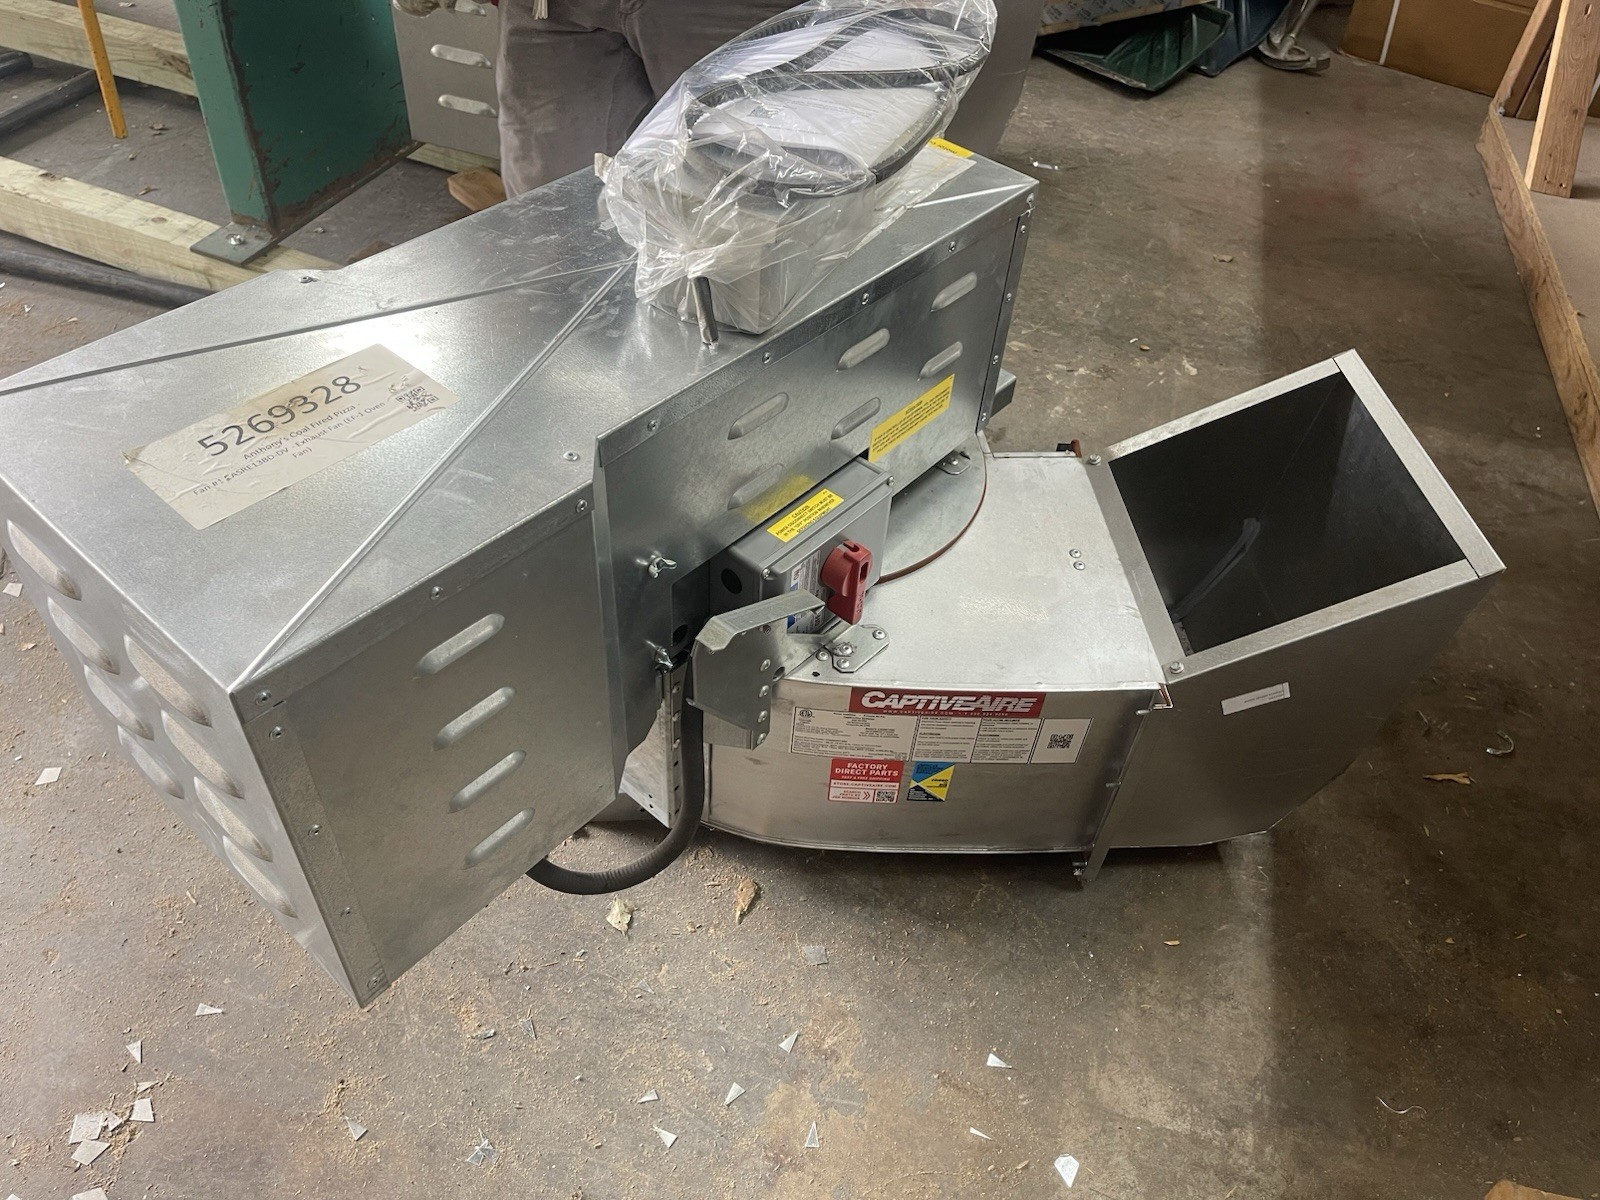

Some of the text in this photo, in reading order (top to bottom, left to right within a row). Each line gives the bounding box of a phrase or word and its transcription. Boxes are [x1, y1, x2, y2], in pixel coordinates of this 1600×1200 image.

[197, 376, 361, 456] 5269328
[243, 436, 290, 460] Anthony's
[290, 424, 311, 438] Coal
[310, 414, 335, 429] Fired
[333, 404, 356, 416] Pizza
[193, 484, 211, 496] Fan
[212, 478, 222, 487] #1
[294, 429, 328, 447] Exhaust
[327, 421, 344, 433] Fan
[342, 411, 365, 425] (EF-1
[364, 402, 386, 414] Oven
[292, 447, 313, 459] Fan)
[792, 505, 810, 518] CAUTION
[793, 569, 800, 580] ON
[861, 691, 1038, 713] CAPTIVEAIRE
[847, 762, 888, 770] FACTORY
